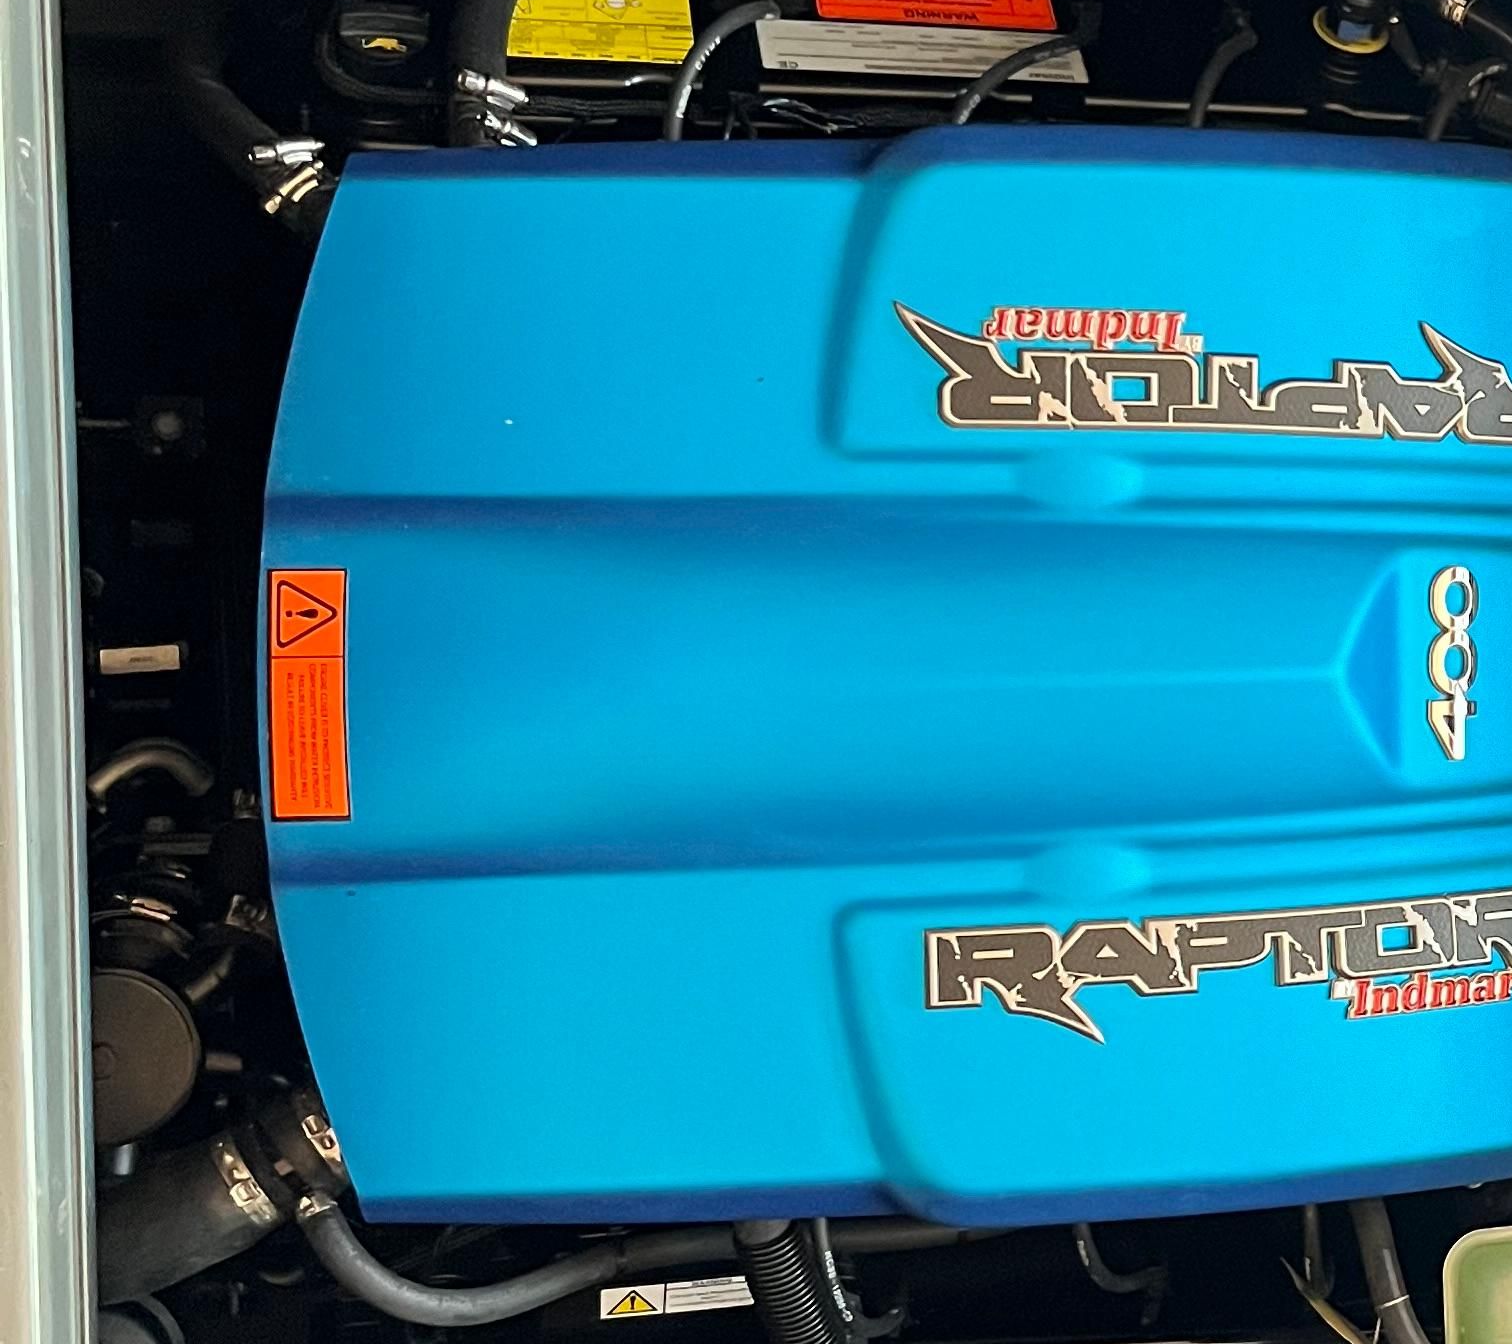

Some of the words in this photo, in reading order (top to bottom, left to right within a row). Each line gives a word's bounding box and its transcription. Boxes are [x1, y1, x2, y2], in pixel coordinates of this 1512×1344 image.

[904, 9, 979, 22] WARNING
[980, 308, 1186, 355] Indmar
[1426, 565, 1479, 762] 400
